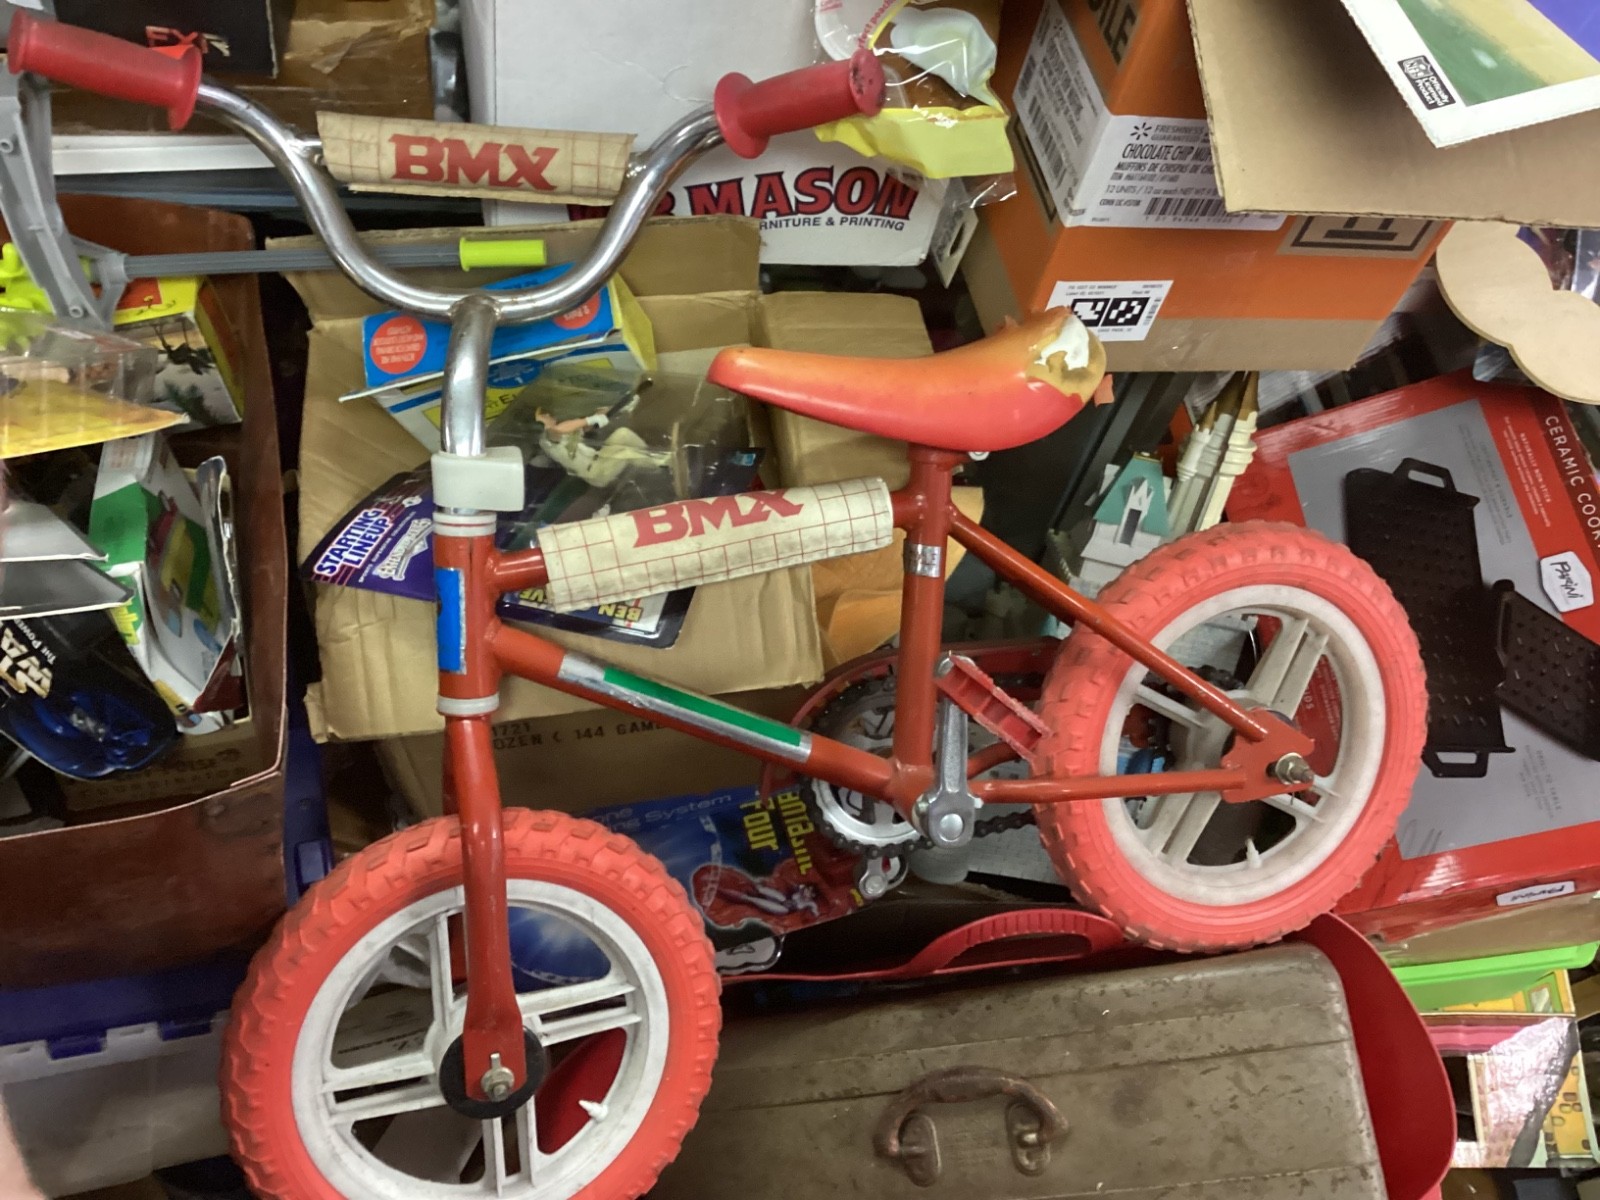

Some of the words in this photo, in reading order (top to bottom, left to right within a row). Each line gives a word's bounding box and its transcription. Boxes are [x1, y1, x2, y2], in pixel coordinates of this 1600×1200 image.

[1415, 79, 1436, 104] Product
[1422, 77, 1445, 106] Licensed
[1429, 76, 1449, 103] Officially
[388, 133, 560, 192] BMX
[1122, 143, 1174, 160] CHOCOLATE
[1171, 145, 1195, 161] CHIP
[683, 165, 919, 220] MASON
[1116, 185, 1137, 194] UNITS
[825, 216, 836, 227] &
[838, 216, 905, 232] PRINTING
[1544, 415, 1586, 487] CERAMIC
[626, 489, 804, 548] BMX
[315, 509, 382, 575] STARTING
[341, 518, 391, 566] LINEUP
[599, 604, 643, 622] BEN
[41, 646, 56, 665] THE
[574, 725, 605, 740] 144
[645, 795, 731, 823] System
[740, 796, 779, 851] Four
